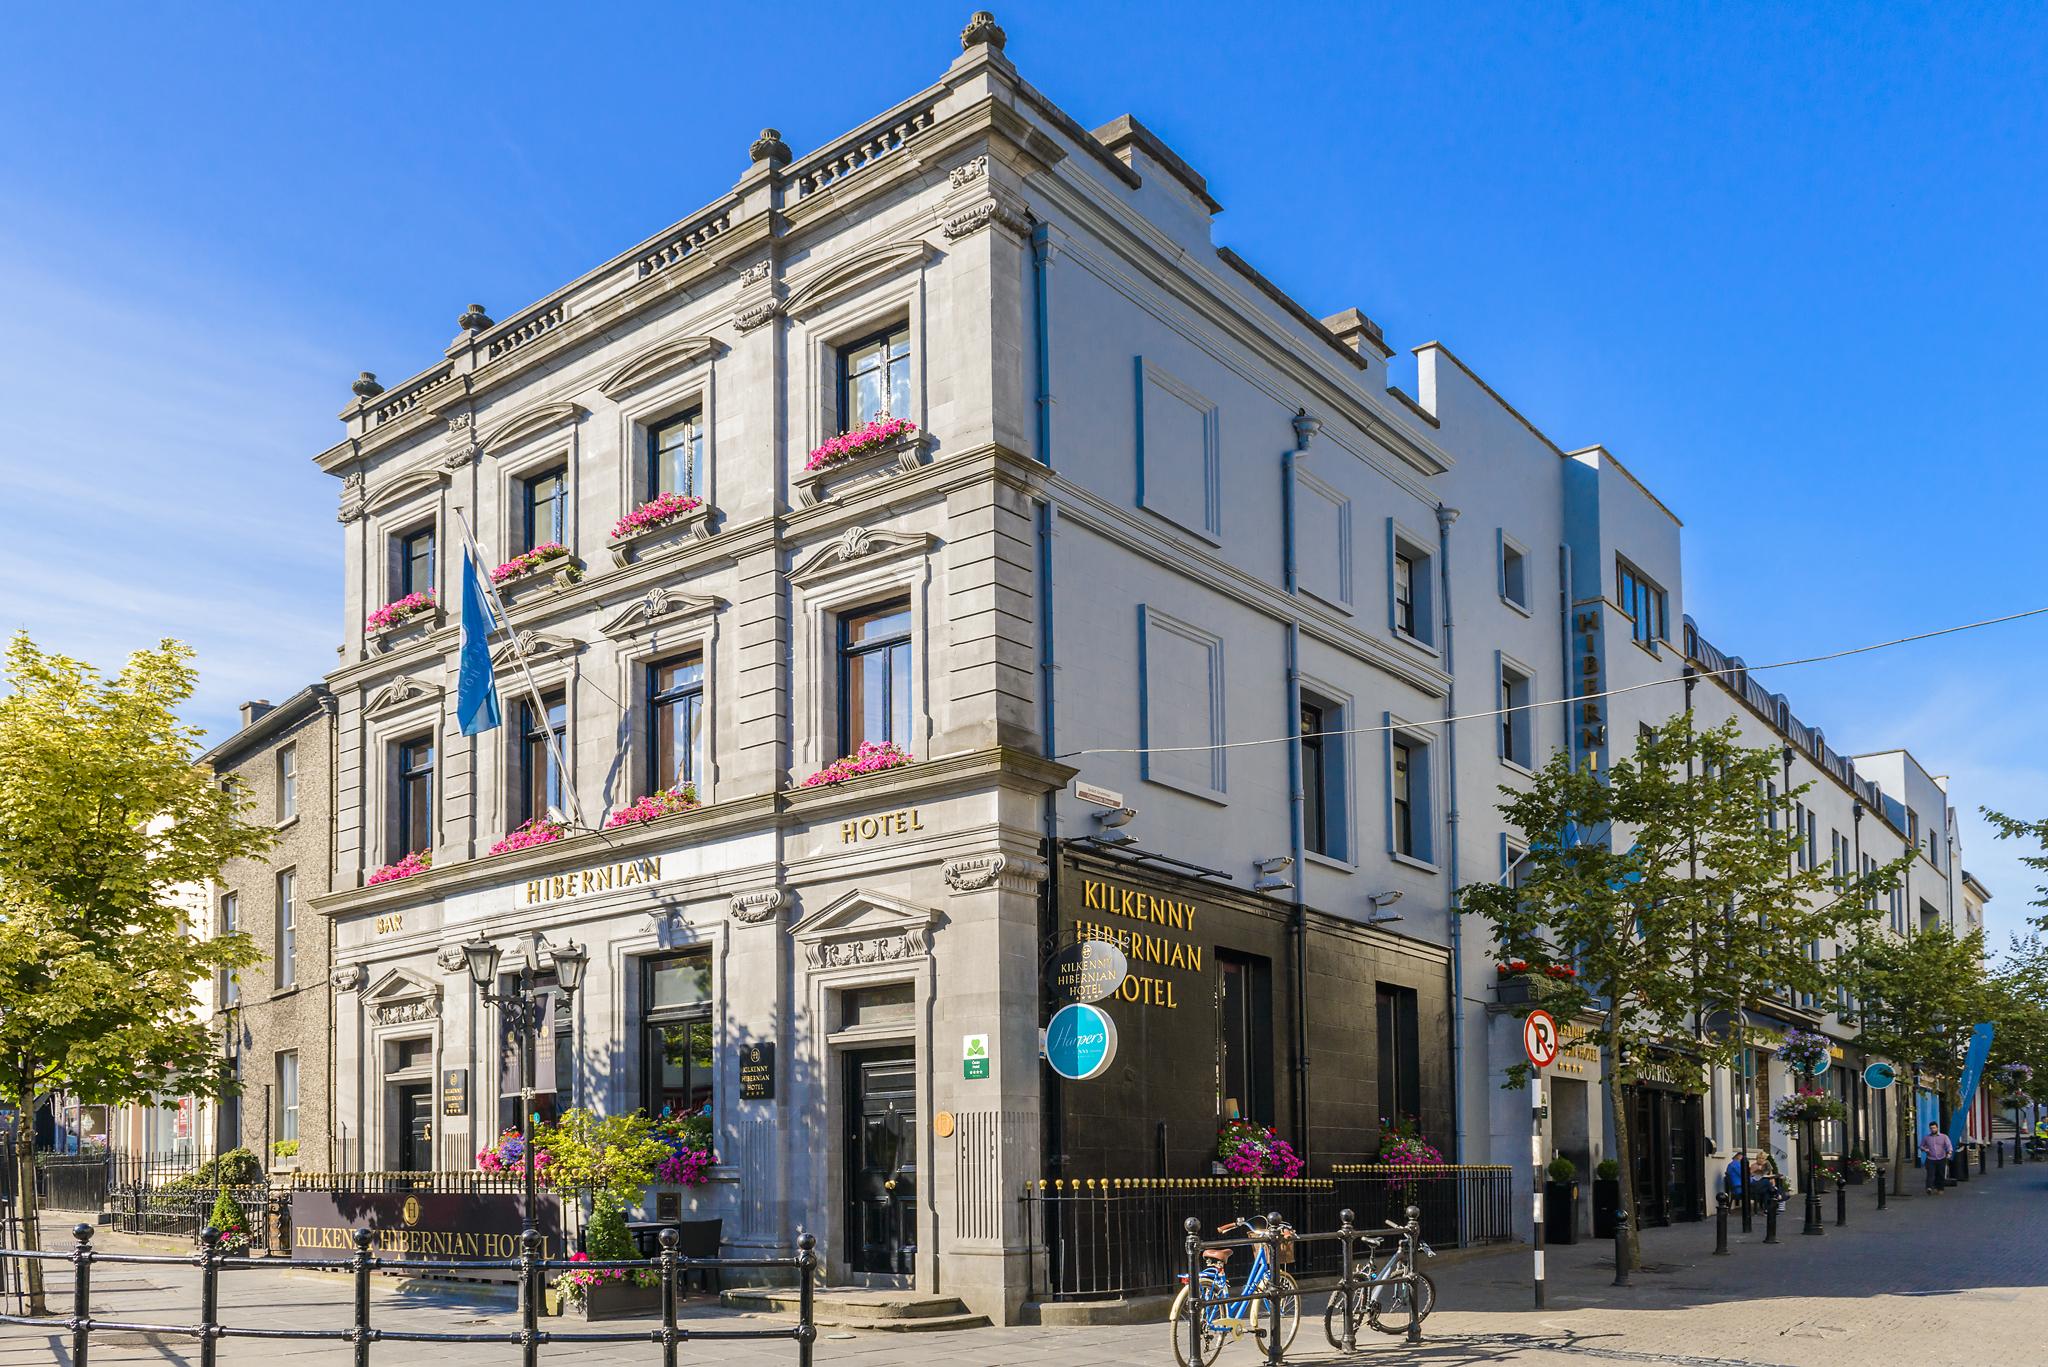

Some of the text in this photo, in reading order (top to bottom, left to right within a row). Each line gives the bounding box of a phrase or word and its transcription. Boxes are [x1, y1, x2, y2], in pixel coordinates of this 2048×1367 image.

[1577, 610, 1605, 777] HIBERNI
[841, 808, 924, 844] HOTEL
[526, 856, 662, 904] HIBERNIAN
[1084, 880, 1196, 931] KILKENNY
[375, 913, 403, 934] BAR
[1058, 970, 1117, 986] HIBERNIAN
[1061, 958, 1113, 973] KILKENNY
[1069, 984, 1103, 996] HOTEL
[1053, 1024, 1104, 1051] Harpers
[1536, 1023, 1548, 1054] P
[741, 1074, 770, 1082] HIBERNIAN
[408, 1202, 416, 1218] H
[380, 1227, 478, 1257] HIBERNIAN
[484, 1233, 556, 1260] HOTL
